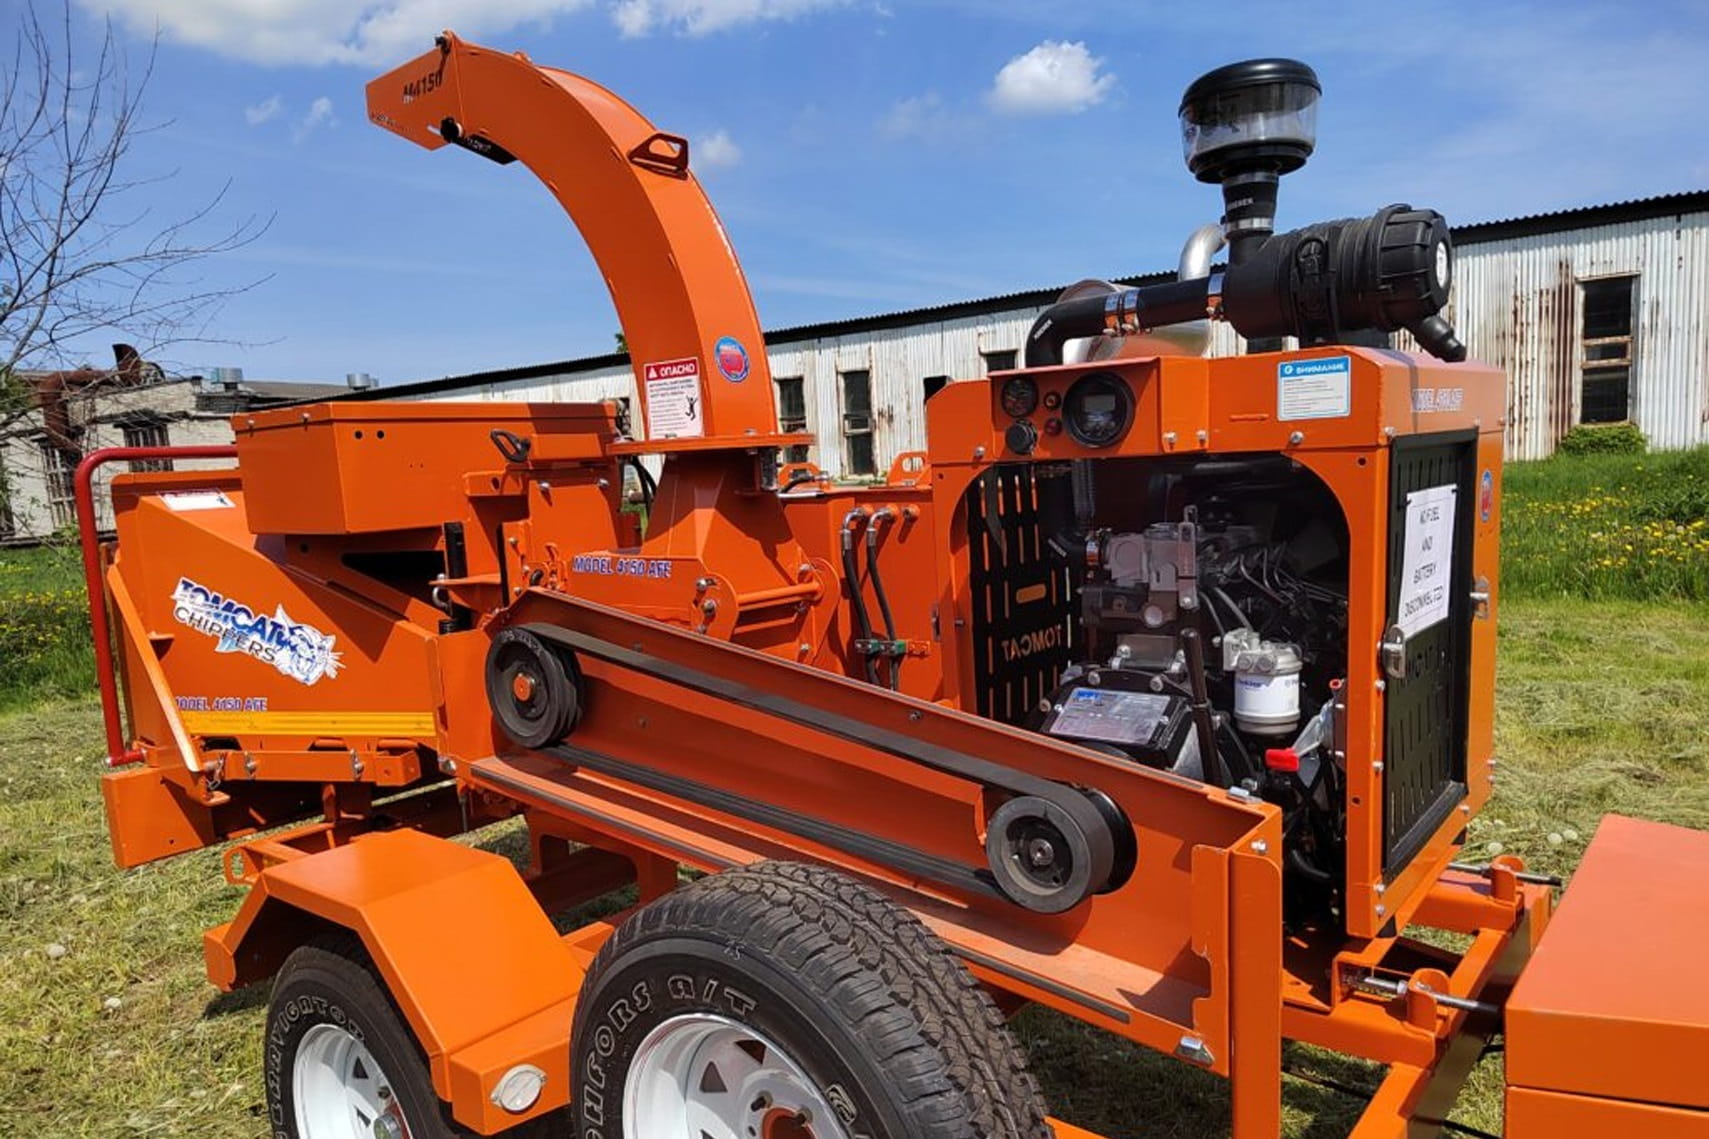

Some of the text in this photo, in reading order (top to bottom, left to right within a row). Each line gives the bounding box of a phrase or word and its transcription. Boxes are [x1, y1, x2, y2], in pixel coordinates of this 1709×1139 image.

[660, 363, 696, 376] ОПАСНО
[573, 556, 613, 574] MODEL
[648, 560, 672, 578] AFE
[176, 579, 286, 644] TOMCAT
[174, 606, 277, 663] CHIPPERS
[244, 697, 268, 711] AFE
